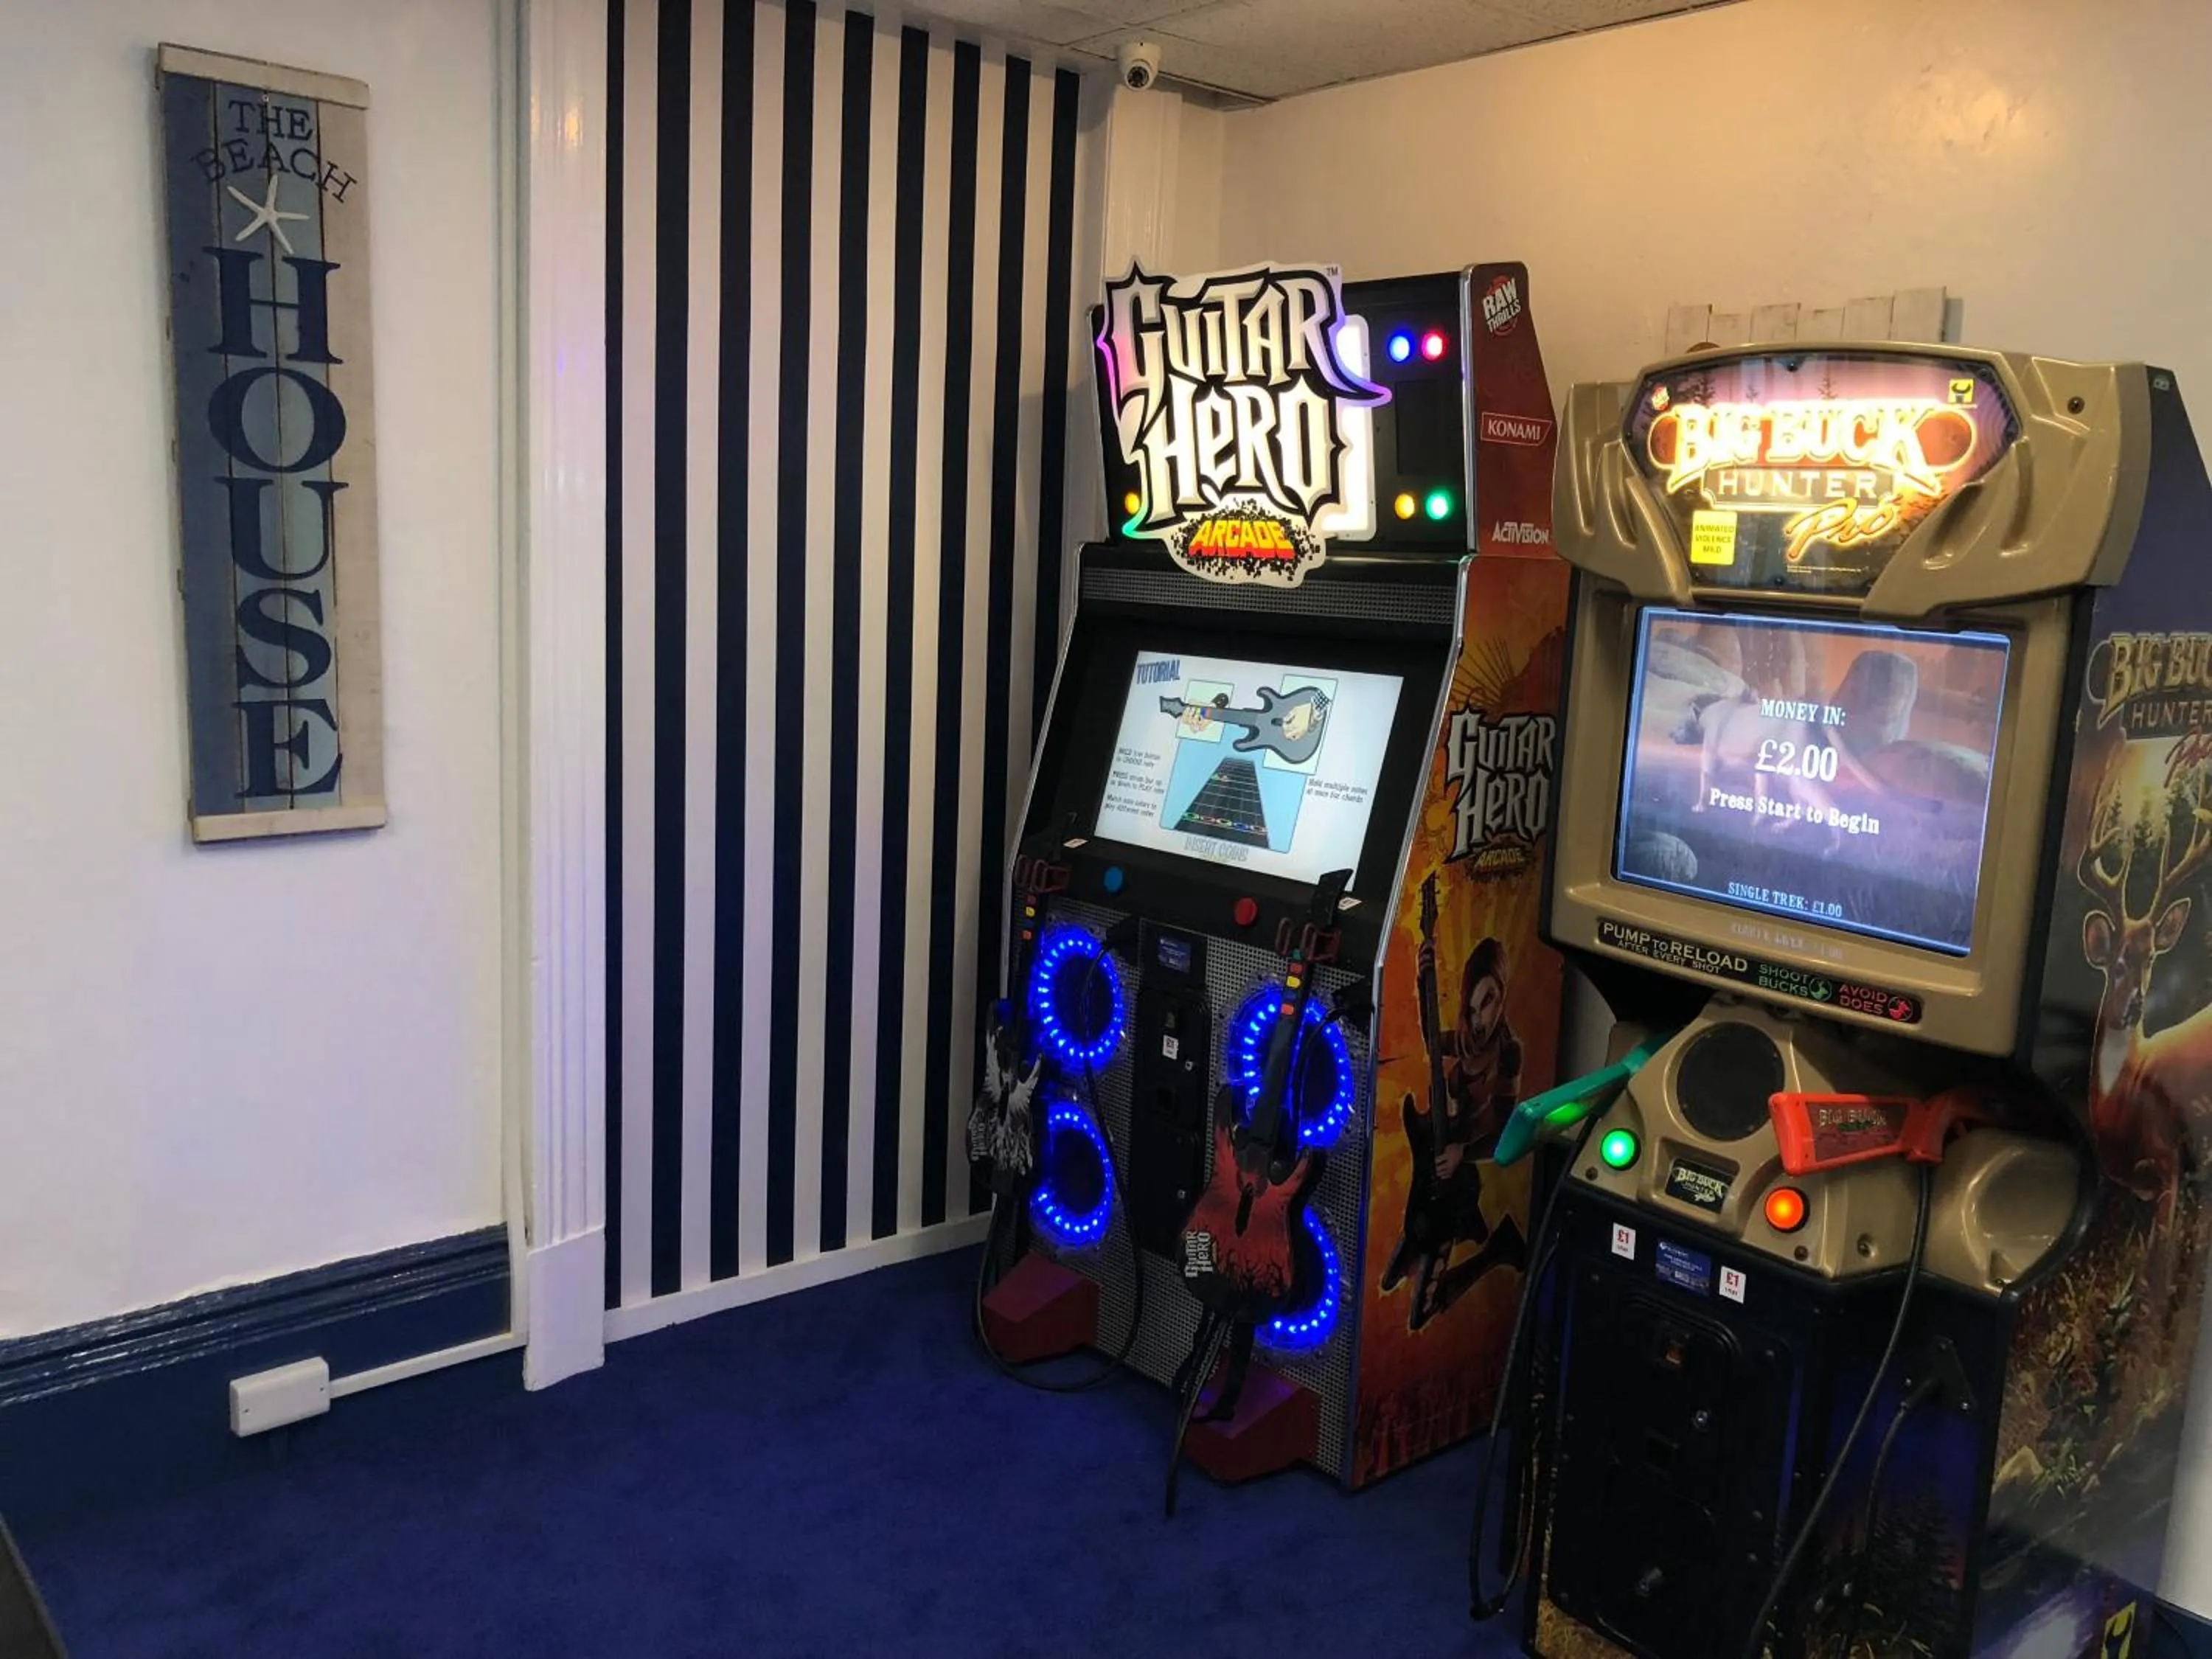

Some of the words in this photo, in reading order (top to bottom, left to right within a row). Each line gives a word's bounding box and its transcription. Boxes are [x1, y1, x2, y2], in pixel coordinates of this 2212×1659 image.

[228, 99, 313, 140] THE
[189, 137, 357, 203] BEACH
[1483, 278, 1517, 319] RAW
[1487, 299, 1521, 333] THRILLS
[1105, 269, 1360, 398] GUITAR
[1488, 419, 1541, 440] KONAMI
[1668, 403, 1762, 494] BIG
[1765, 400, 1942, 497] BUCK
[1718, 470, 1877, 498] HUNTER
[203, 245, 350, 799] HOUSE
[1189, 519, 1295, 559] ARCADE
[1492, 520, 1549, 544] ACTIVISION
[1784, 496, 1896, 560] Pro
[1136, 659, 1180, 685] TUTORIAL
[2099, 633, 2164, 726] BIG
[1761, 698, 1818, 723] MONEY
[1823, 706, 1846, 726] IN:
[1447, 708, 1554, 784] GUITAR
[1754, 739, 1838, 782] £2.00
[1709, 787, 1753, 812] Press
[1756, 796, 1801, 821] Start
[1806, 806, 1823, 824] to
[1828, 807, 1880, 835] Begin
[1728, 882, 1770, 903] SINGLE
[1772, 890, 1808, 911] TREK:
[1812, 900, 1843, 918] £1.00
[1604, 922, 1651, 945] PUMP
[1652, 938, 1669, 952] TO
[1670, 941, 1748, 972] RELOAD
[1617, 939, 1649, 955] AFTER
[1653, 949, 1686, 966] EVERY
[1692, 960, 1721, 974] SHOT
[1759, 964, 1809, 984] SHOOT
[1759, 975, 1809, 996] BUCKS
[1839, 984, 1888, 1003] AVOID
[1840, 995, 1884, 1015] DOES
